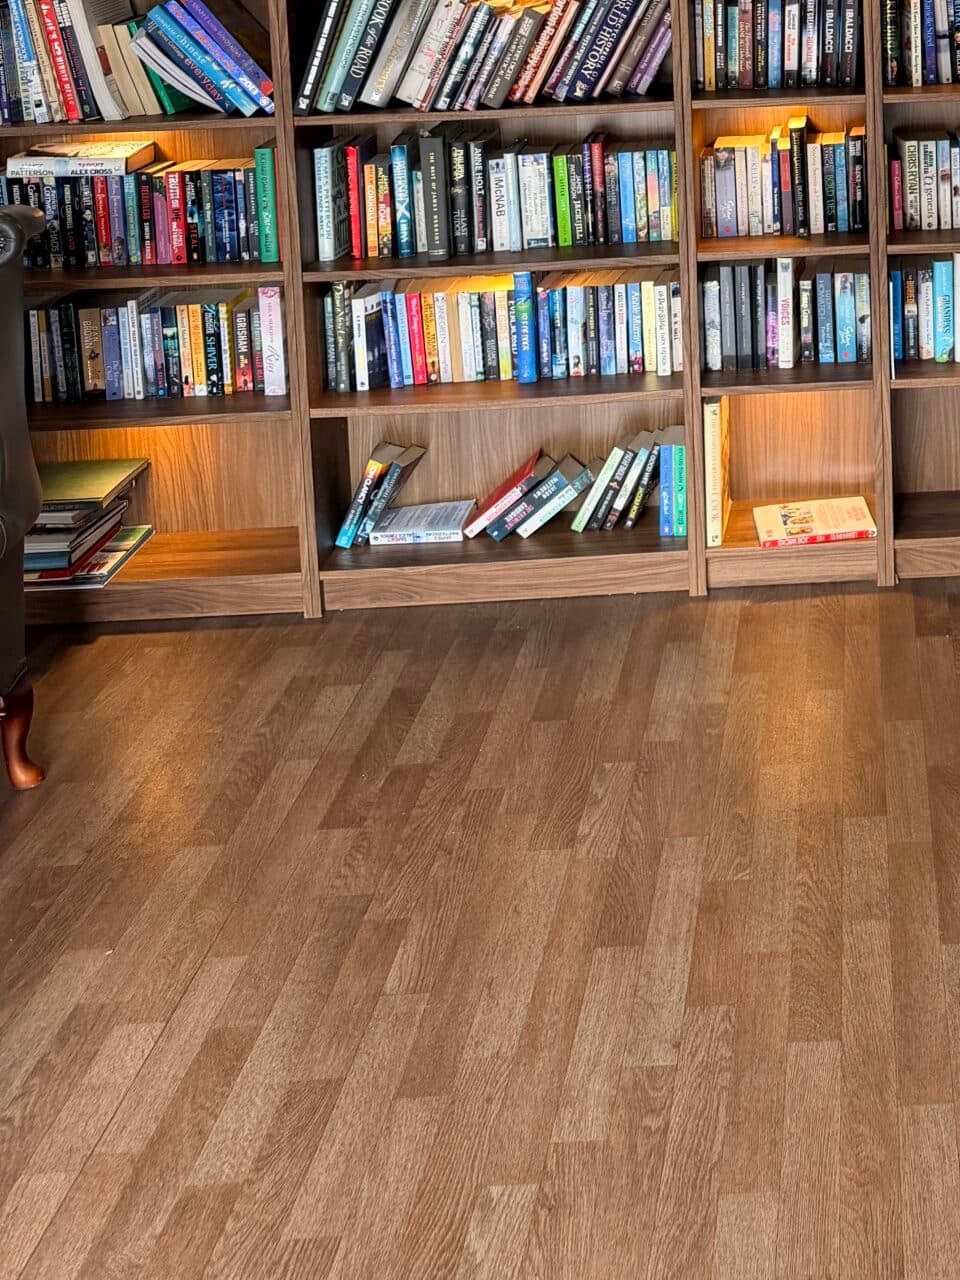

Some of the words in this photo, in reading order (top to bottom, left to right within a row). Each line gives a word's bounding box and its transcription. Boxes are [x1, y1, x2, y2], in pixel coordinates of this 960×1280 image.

[366, 35, 378, 47] the
[595, 13, 627, 69] ENCYCLOPEDIA
[825, 13, 833, 53] BALDACCI
[845, 13, 853, 53] BALDACCI
[175, 34, 209, 64] chinese
[528, 27, 554, 67] Ramsay
[580, 26, 615, 79] HISTORY
[55, 57, 69, 81] MINUTE
[350, 47, 373, 78] ROAD
[504, 62, 515, 81] DIGEST
[589, 71, 599, 81] OF
[184, 58, 223, 102] everyday
[474, 148, 483, 171] ANNE
[907, 145, 917, 169] CHRIS
[169, 173, 179, 199] TRUTH
[476, 173, 484, 195] HOLT
[569, 164, 577, 198] PATTERSON
[825, 174, 833, 197] BOLD
[909, 170, 918, 194] RYAN
[44, 186, 53, 220] Cornwell
[495, 180, 505, 217] McNAB
[574, 200, 582, 220] JACK
[826, 200, 834, 215] LIES
[925, 188, 933, 218] genesis
[453, 210, 461, 237] TUDOR
[575, 223, 583, 240] JILL
[497, 296, 506, 312] THE
[631, 291, 640, 314] Annie
[906, 281, 914, 304] BURIED
[781, 298, 790, 326] VOICES
[943, 295, 952, 334] GRANDPA'S
[83, 321, 94, 348] BROWN
[236, 317, 248, 352] GRISHAM
[498, 315, 508, 341] GIRLS
[632, 315, 641, 345] Murray
[206, 336, 217, 370] SHIVER
